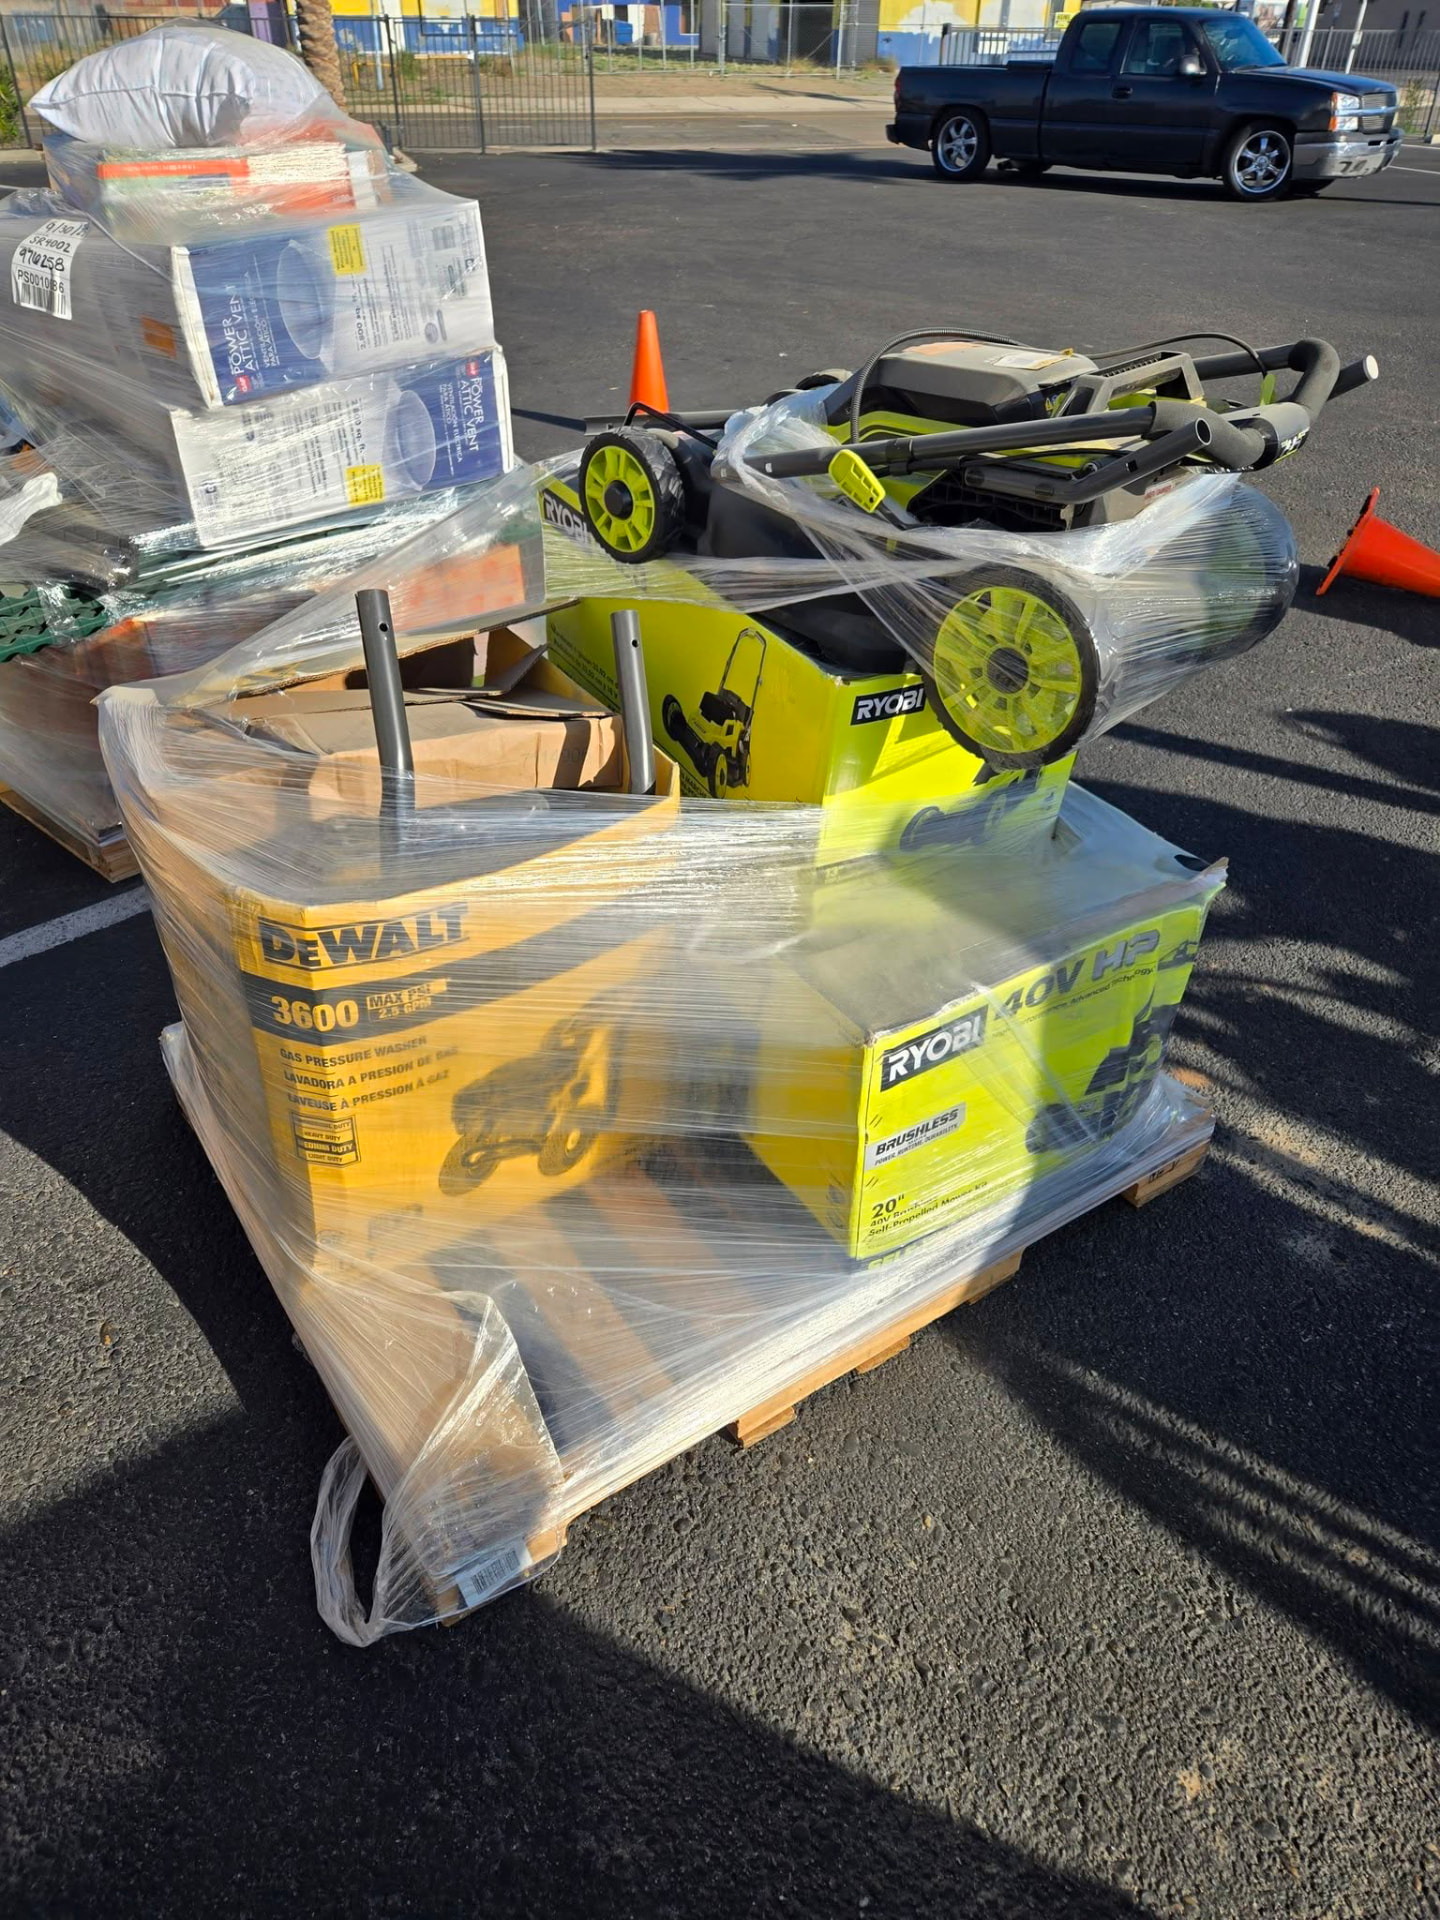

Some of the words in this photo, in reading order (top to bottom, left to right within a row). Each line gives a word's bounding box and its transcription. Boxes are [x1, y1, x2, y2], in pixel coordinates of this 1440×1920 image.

[222, 317, 244, 374] POWER
[236, 329, 256, 371] ATTIC
[460, 380, 474, 415] ATTIC
[470, 377, 485, 424] POWER
[466, 418, 478, 452] VENT
[544, 493, 589, 544] RYOBI
[857, 688, 924, 720] RYOBI
[258, 902, 469, 967] DEWALT
[994, 959, 1086, 1020] 40V
[1092, 929, 1161, 981] HP
[271, 995, 360, 1031] 3600
[369, 993, 406, 1009] MAX
[378, 1004, 400, 1019] 2.5
[280, 1048, 302, 1063] GAS
[305, 1048, 372, 1068] PRESSURE
[374, 1035, 427, 1058] WASHER
[889, 1015, 981, 1082] RYOBI
[284, 1070, 345, 1090] LAVADORA
[347, 1075, 357, 1086] A
[360, 1061, 414, 1083] PRESION
[417, 1055, 432, 1068] DE
[287, 1092, 338, 1112] LAVEUSE
[340, 1097, 350, 1110] À
[352, 1081, 413, 1107] PRESSION
[331, 1143, 353, 1153] DUTY
[876, 1108, 959, 1156] BRUSHLESS
[868, 1202, 939, 1237] Self-Propelled
[870, 1214, 892, 1228] 40V
[872, 1193, 905, 1219] 20"
